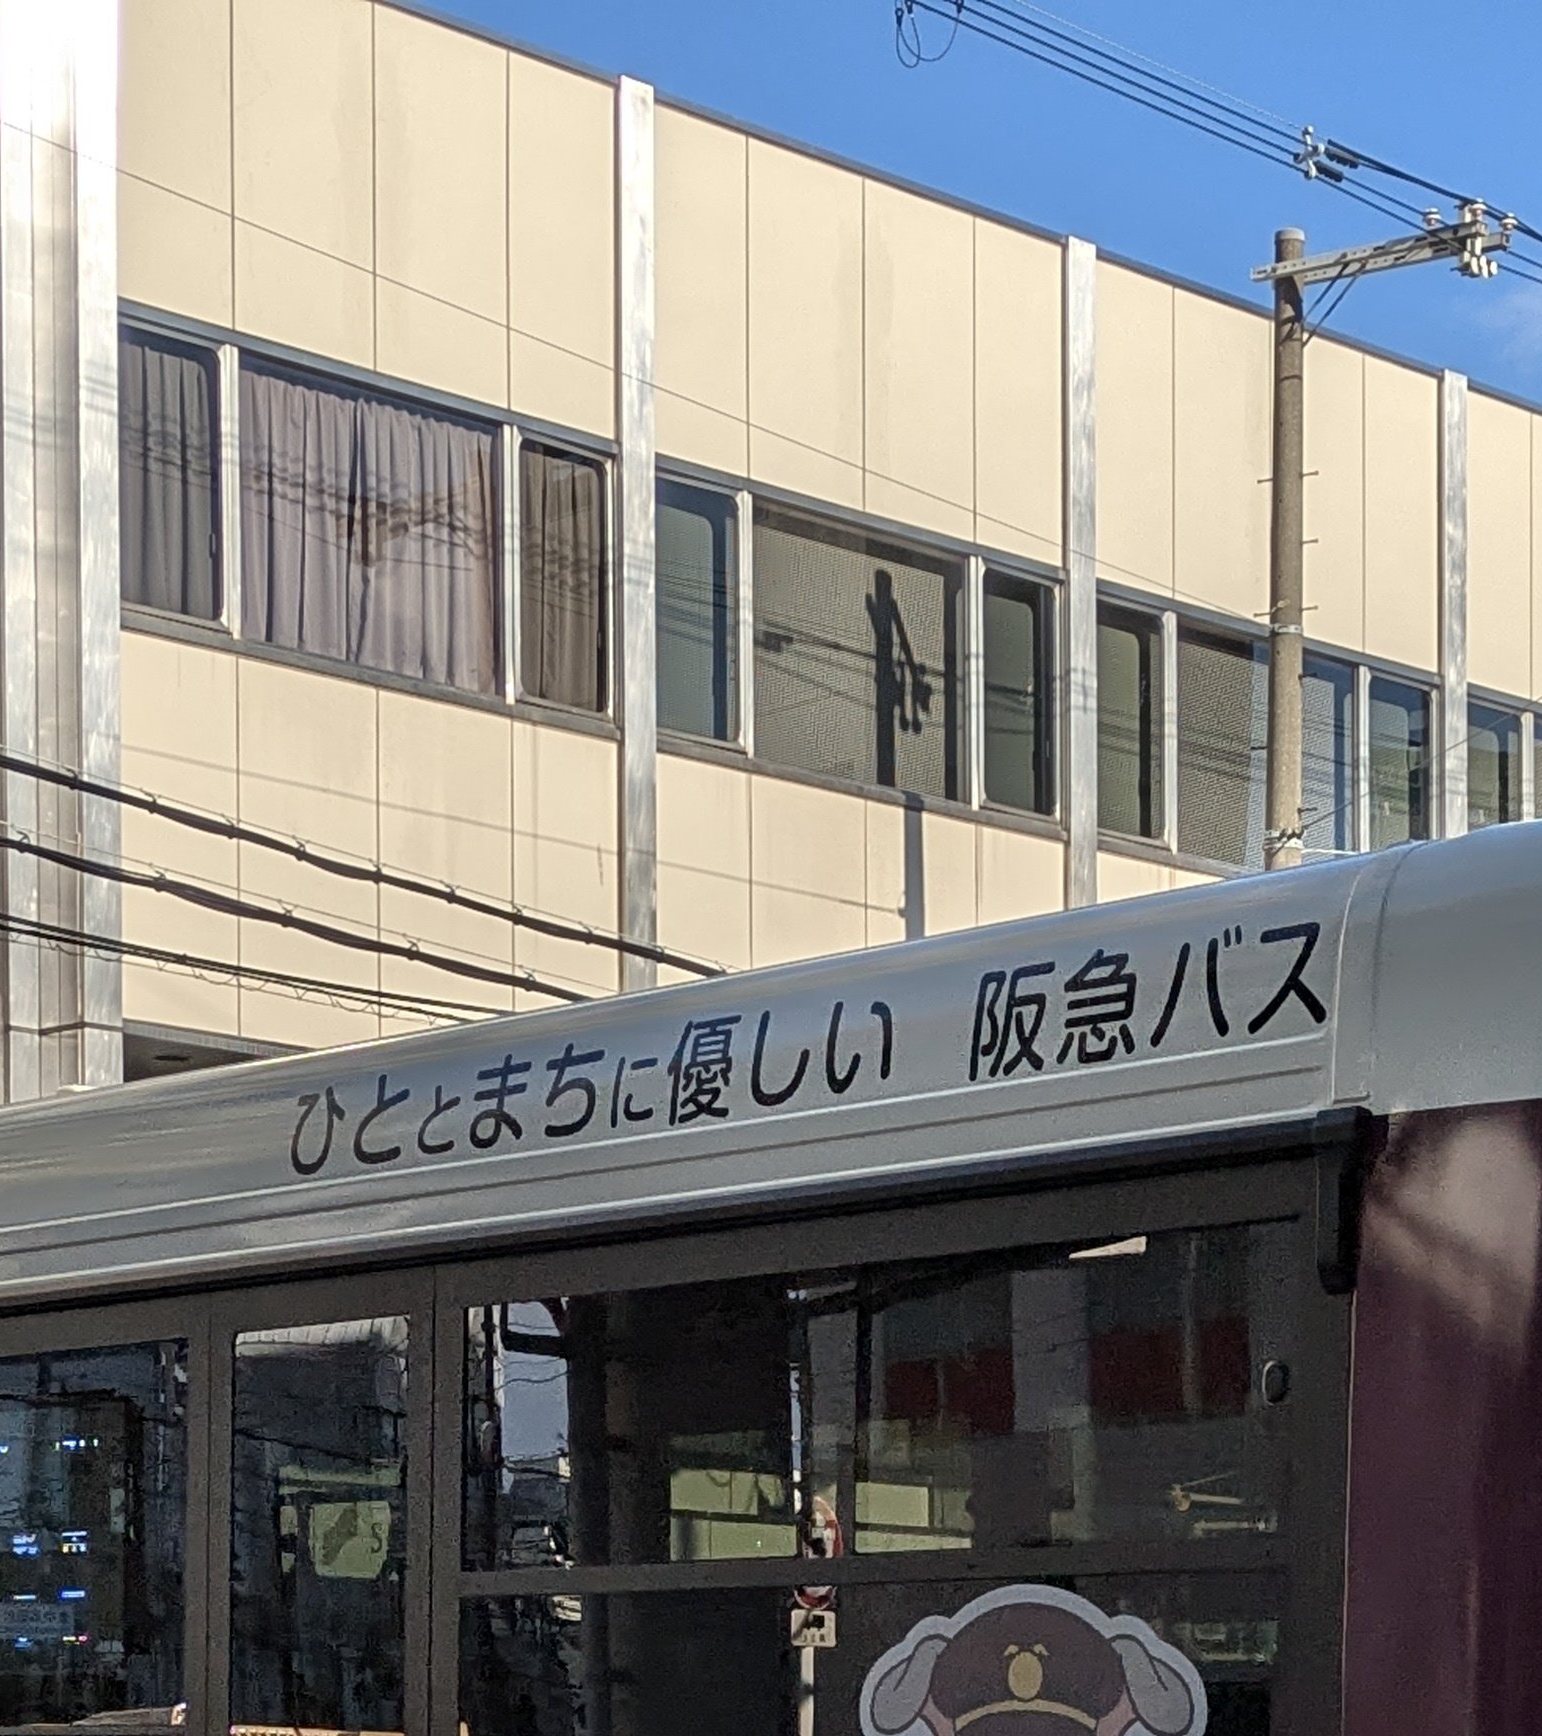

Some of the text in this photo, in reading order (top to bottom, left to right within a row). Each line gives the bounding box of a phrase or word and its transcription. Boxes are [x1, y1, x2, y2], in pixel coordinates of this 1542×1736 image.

[291, 920, 1327, 1175] ひととまちに優しい 阪急バス
